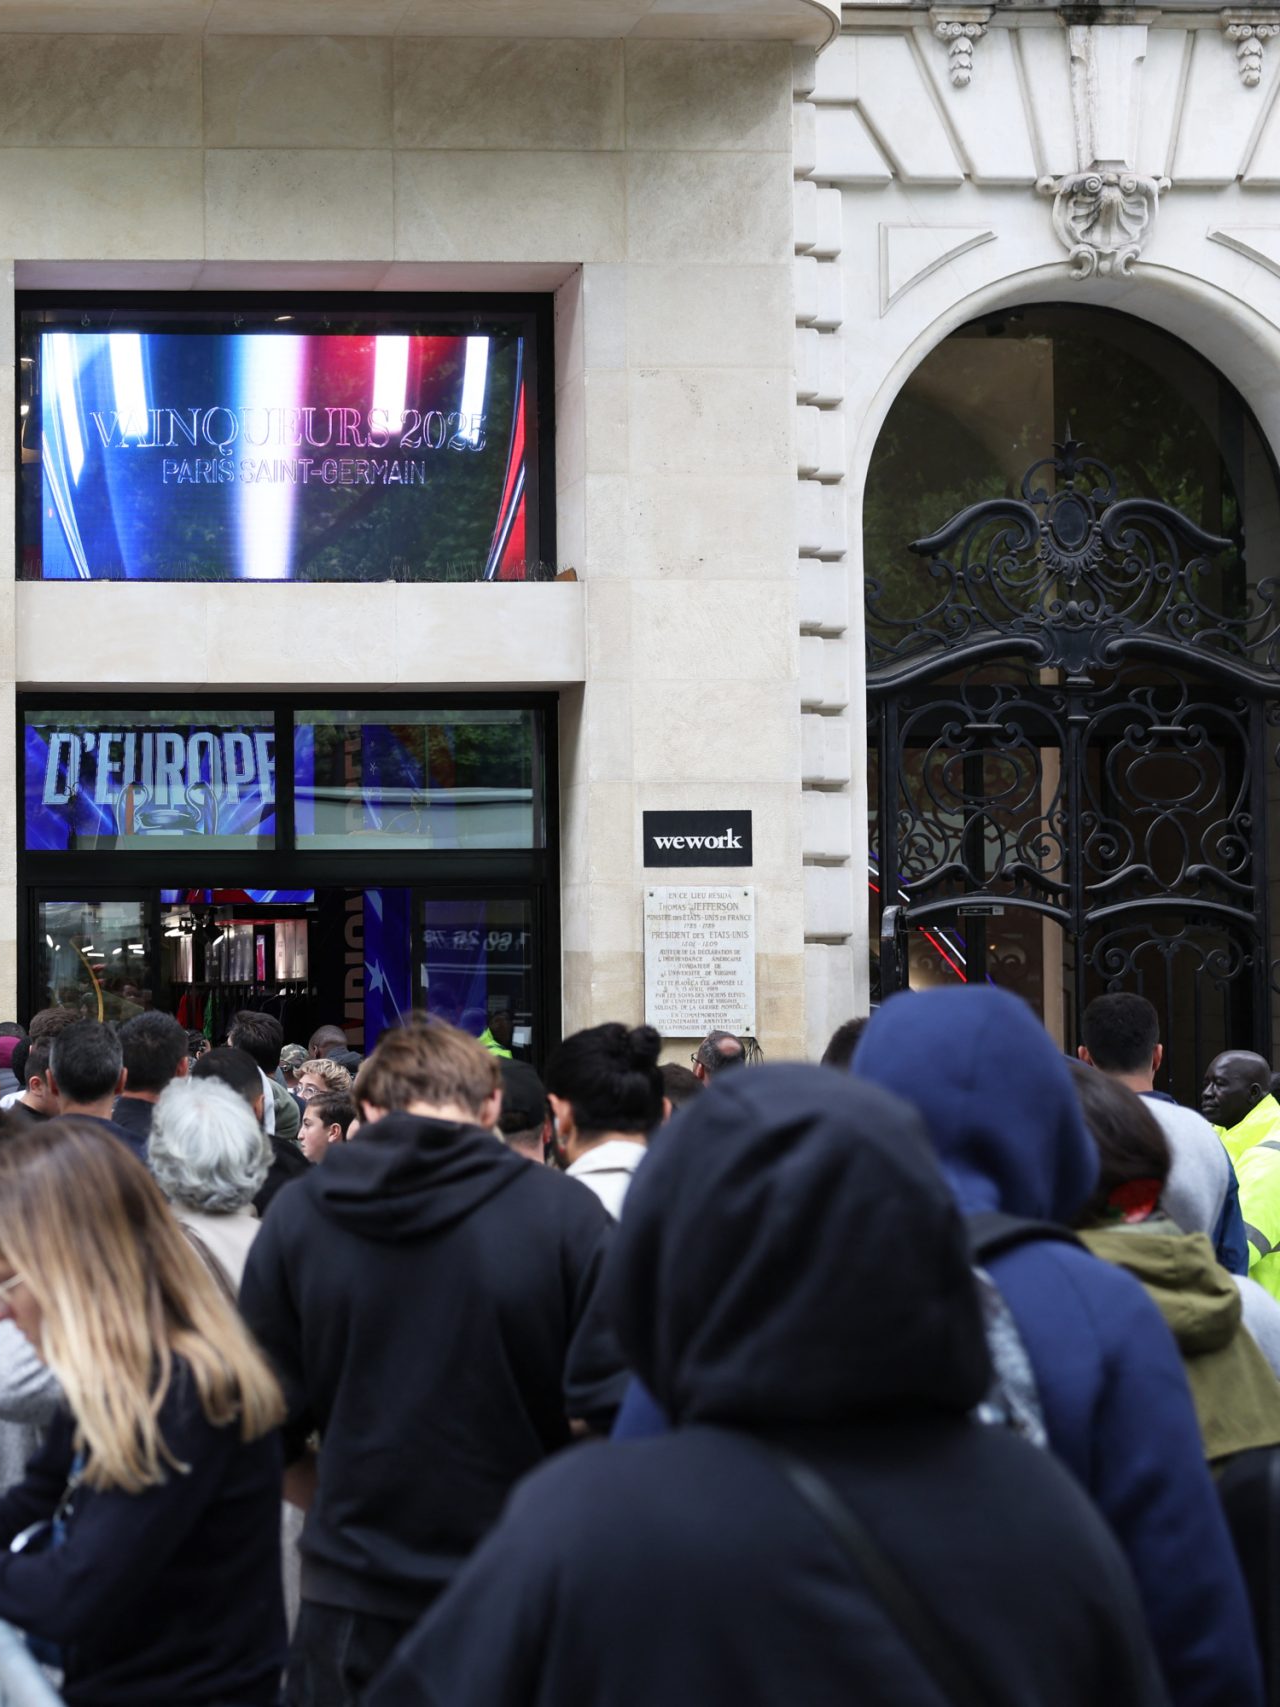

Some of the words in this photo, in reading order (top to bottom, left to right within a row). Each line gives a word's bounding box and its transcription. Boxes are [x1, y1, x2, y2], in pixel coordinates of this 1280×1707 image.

[89, 406, 390, 456] VAINQUEURS
[400, 409, 487, 452] 2025
[163, 458, 234, 484] PARIS
[239, 458, 426, 485] SAINT-GERMAIN
[42, 732, 276, 805] D'EUROPE
[653, 828, 743, 850] wework
